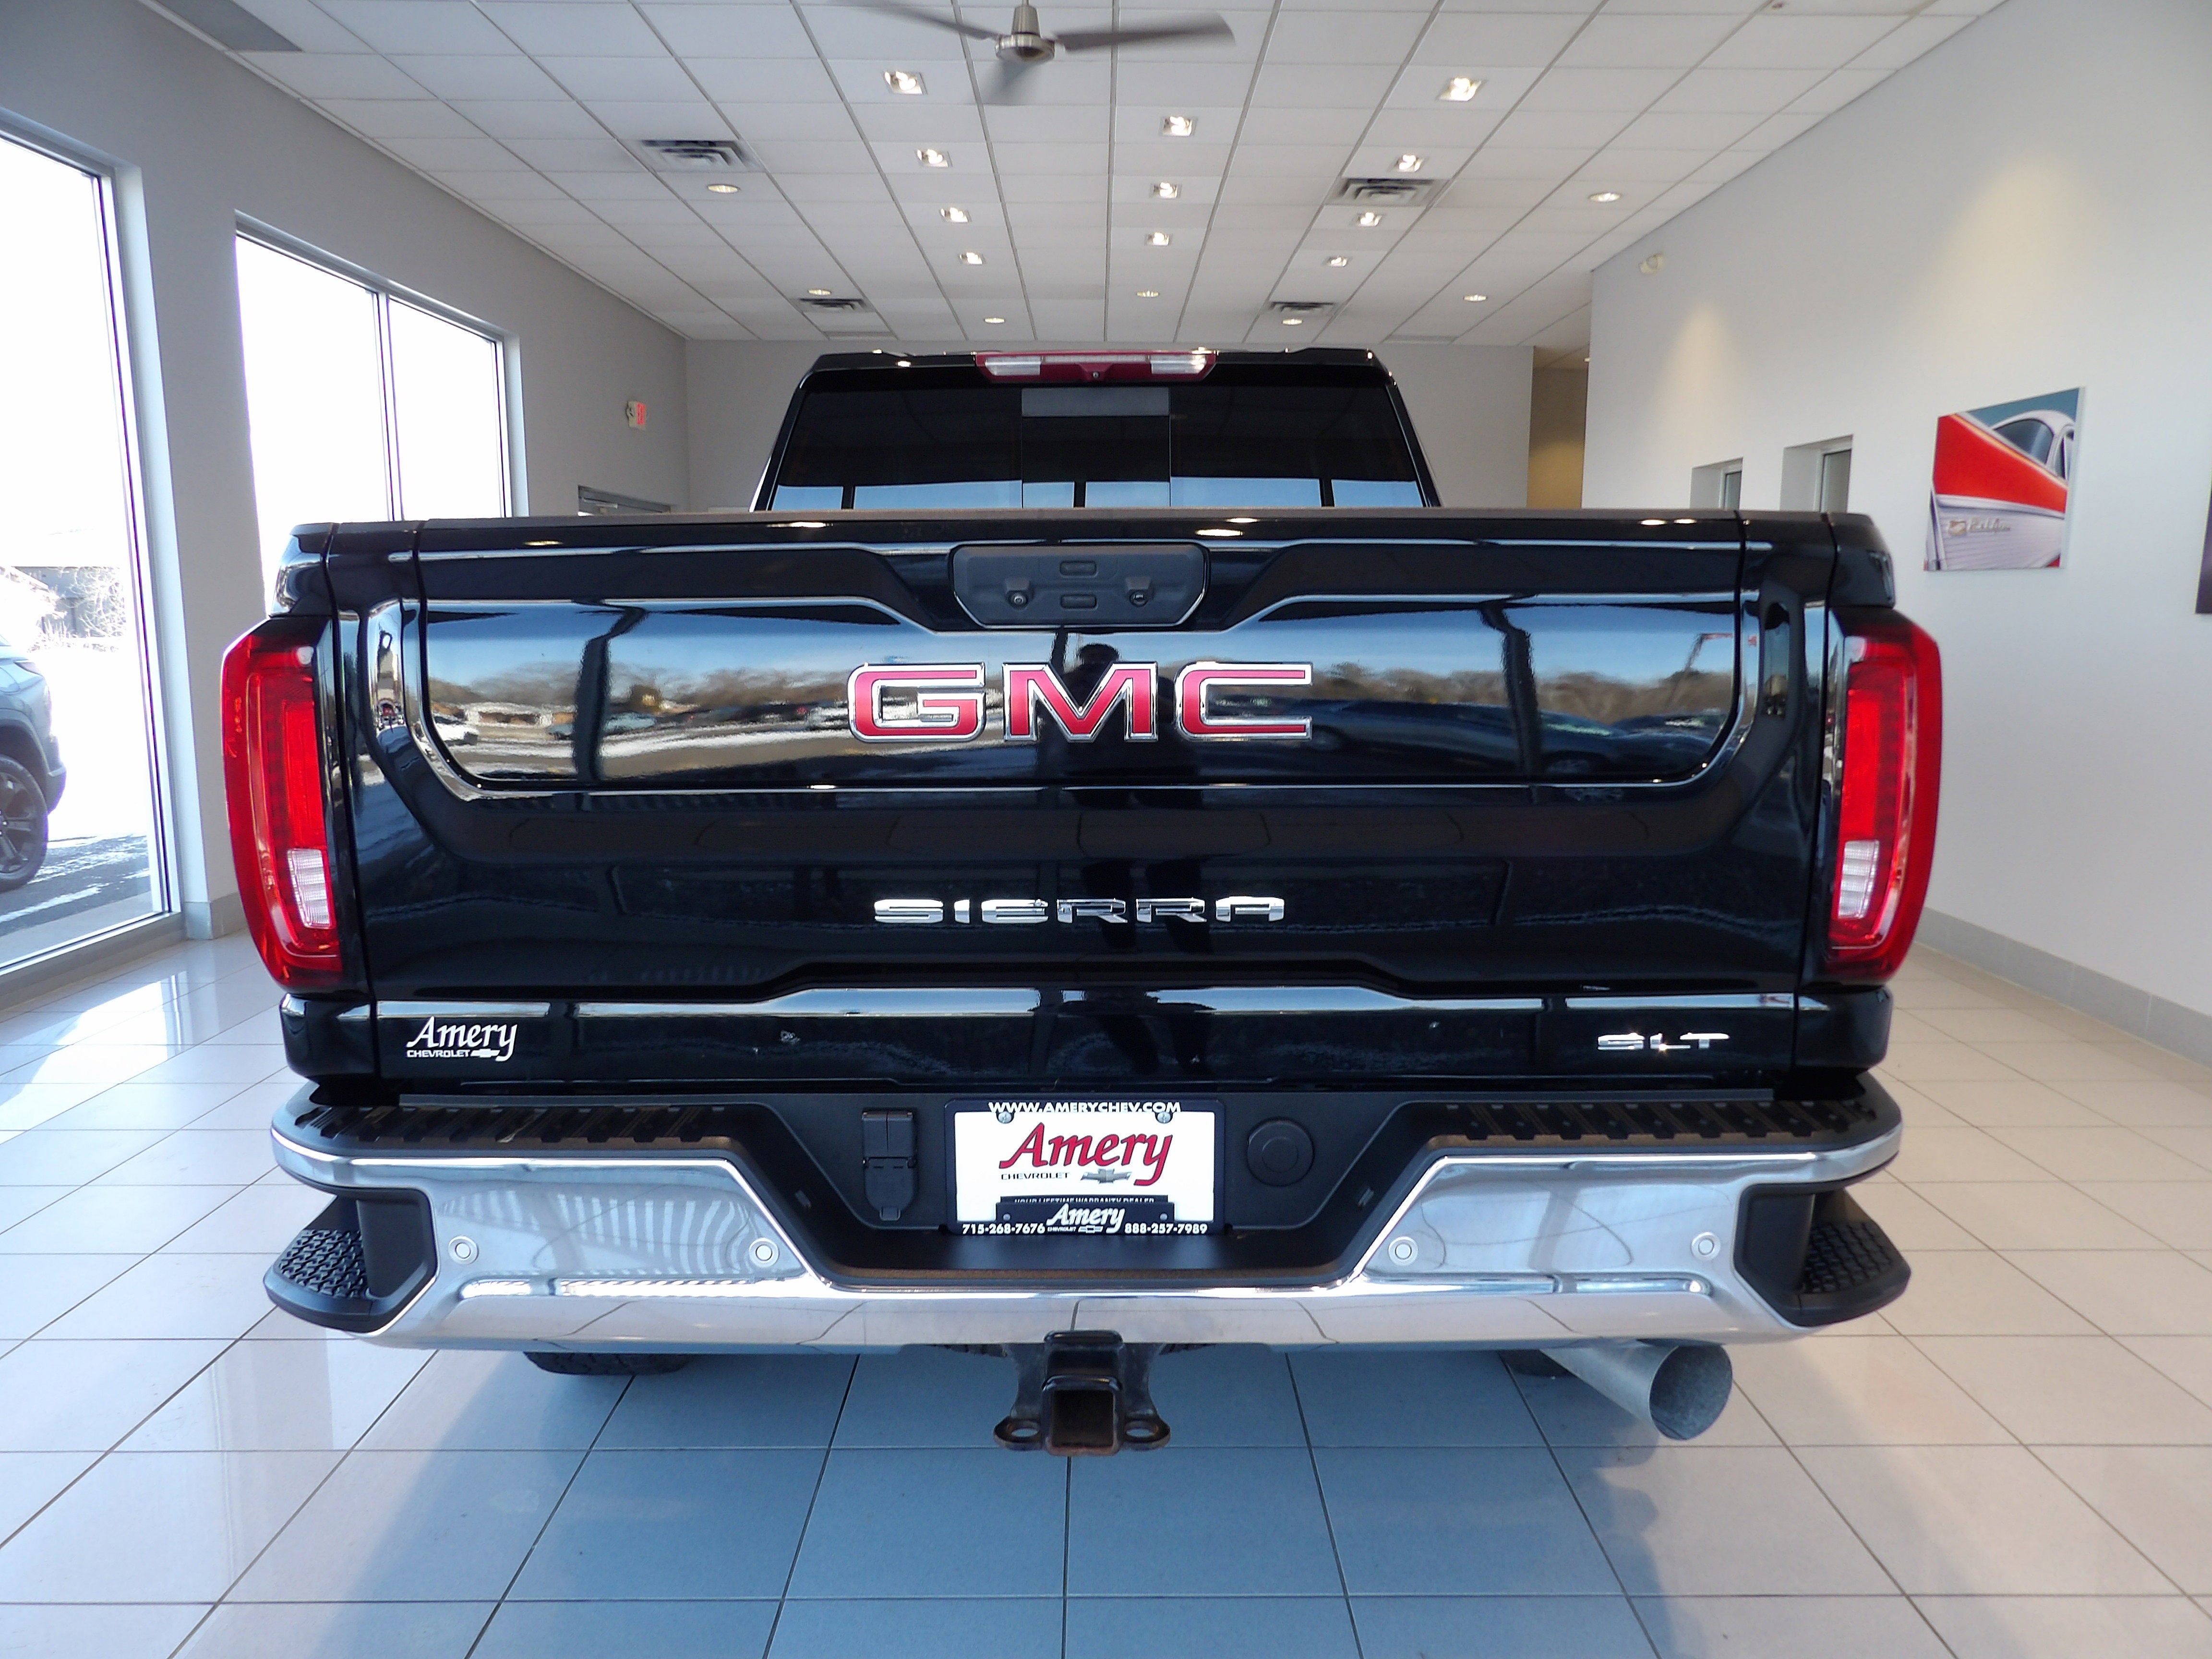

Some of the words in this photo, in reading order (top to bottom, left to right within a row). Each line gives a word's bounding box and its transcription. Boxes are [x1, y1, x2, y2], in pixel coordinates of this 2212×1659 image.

[848, 662, 1312, 742] GMC
[874, 895, 1285, 924] SIERRA
[406, 1016, 517, 1061] Amery
[1598, 1033, 1730, 1050] SLT
[407, 1049, 470, 1058] CHEVROLET
[988, 1102, 1181, 1113] WWW.AMERYCHEV.COM
[998, 1122, 1173, 1186] Amery
[1001, 1172, 1070, 1180] CHEVROLET
[1046, 1203, 1125, 1234] Amery
[962, 1224, 1045, 1234] 715-268-7676
[1124, 1223, 1208, 1234] 888-257-7989
